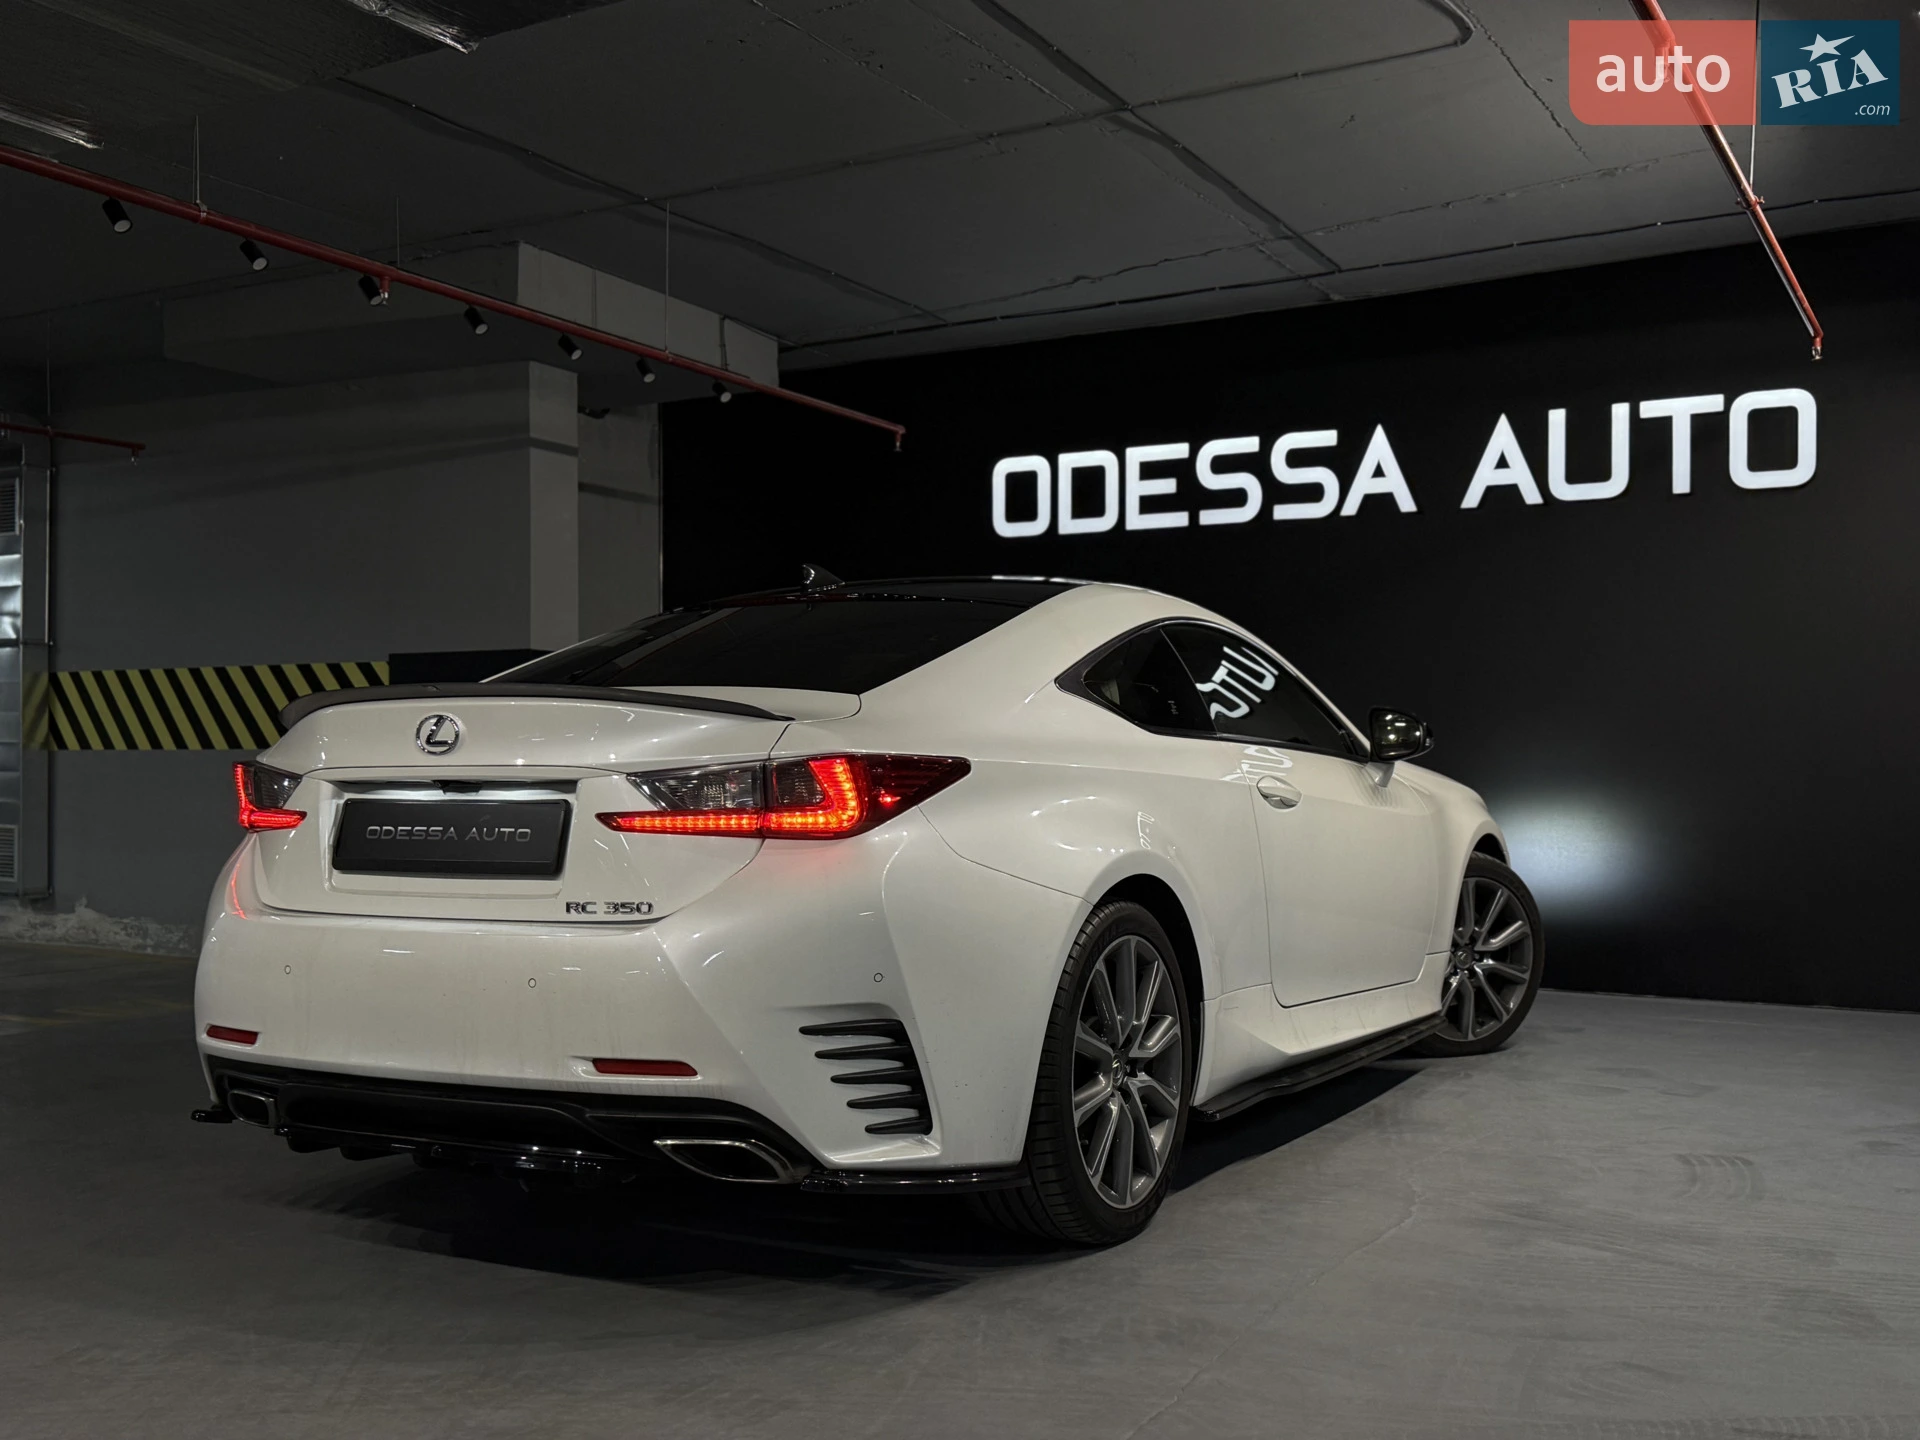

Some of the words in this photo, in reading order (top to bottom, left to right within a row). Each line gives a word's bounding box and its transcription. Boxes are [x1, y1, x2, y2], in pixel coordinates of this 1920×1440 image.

[991, 424, 1418, 538] ODESSA
[1460, 388, 1818, 509] AUTO
[366, 825, 458, 841] ODESSA
[465, 826, 532, 843] AUTO
[565, 901, 597, 915] RC
[603, 901, 654, 916] 350
